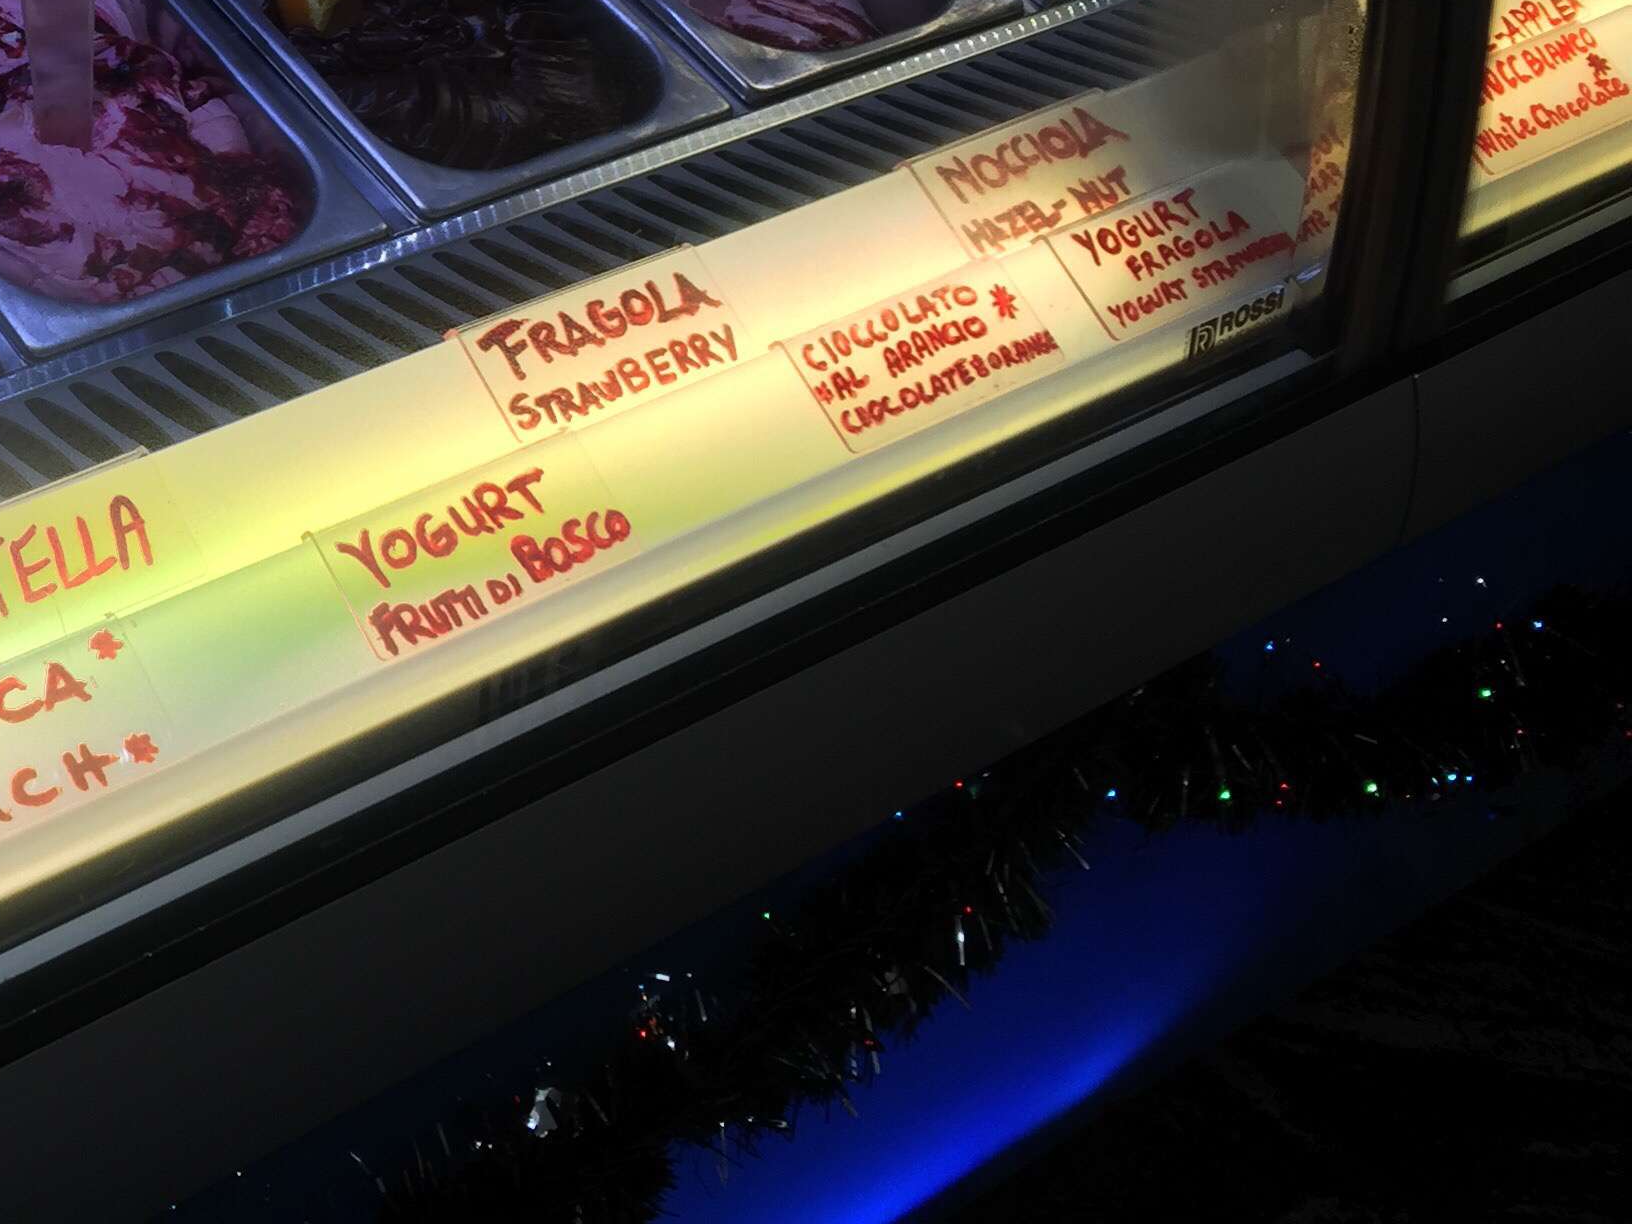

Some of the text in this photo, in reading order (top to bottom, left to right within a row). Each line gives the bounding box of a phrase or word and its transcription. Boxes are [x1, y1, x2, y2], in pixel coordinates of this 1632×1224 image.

[935, 107, 1132, 204] NOCCIOLA
[1070, 187, 1201, 266] YOGURT
[1125, 210, 1250, 281] FRAGOLA
[475, 272, 722, 380] FRAGOLA
[801, 284, 977, 372] CIOCCOLATO
[883, 316, 988, 376] ARANCIO
[1107, 278, 1188, 329] YOGURT
[1219, 287, 1285, 337] ROSSI
[508, 323, 738, 431] STRAWBERRY
[336, 466, 544, 588] YOGURT
[369, 508, 632, 656] FRUTTI DI BOSCO
